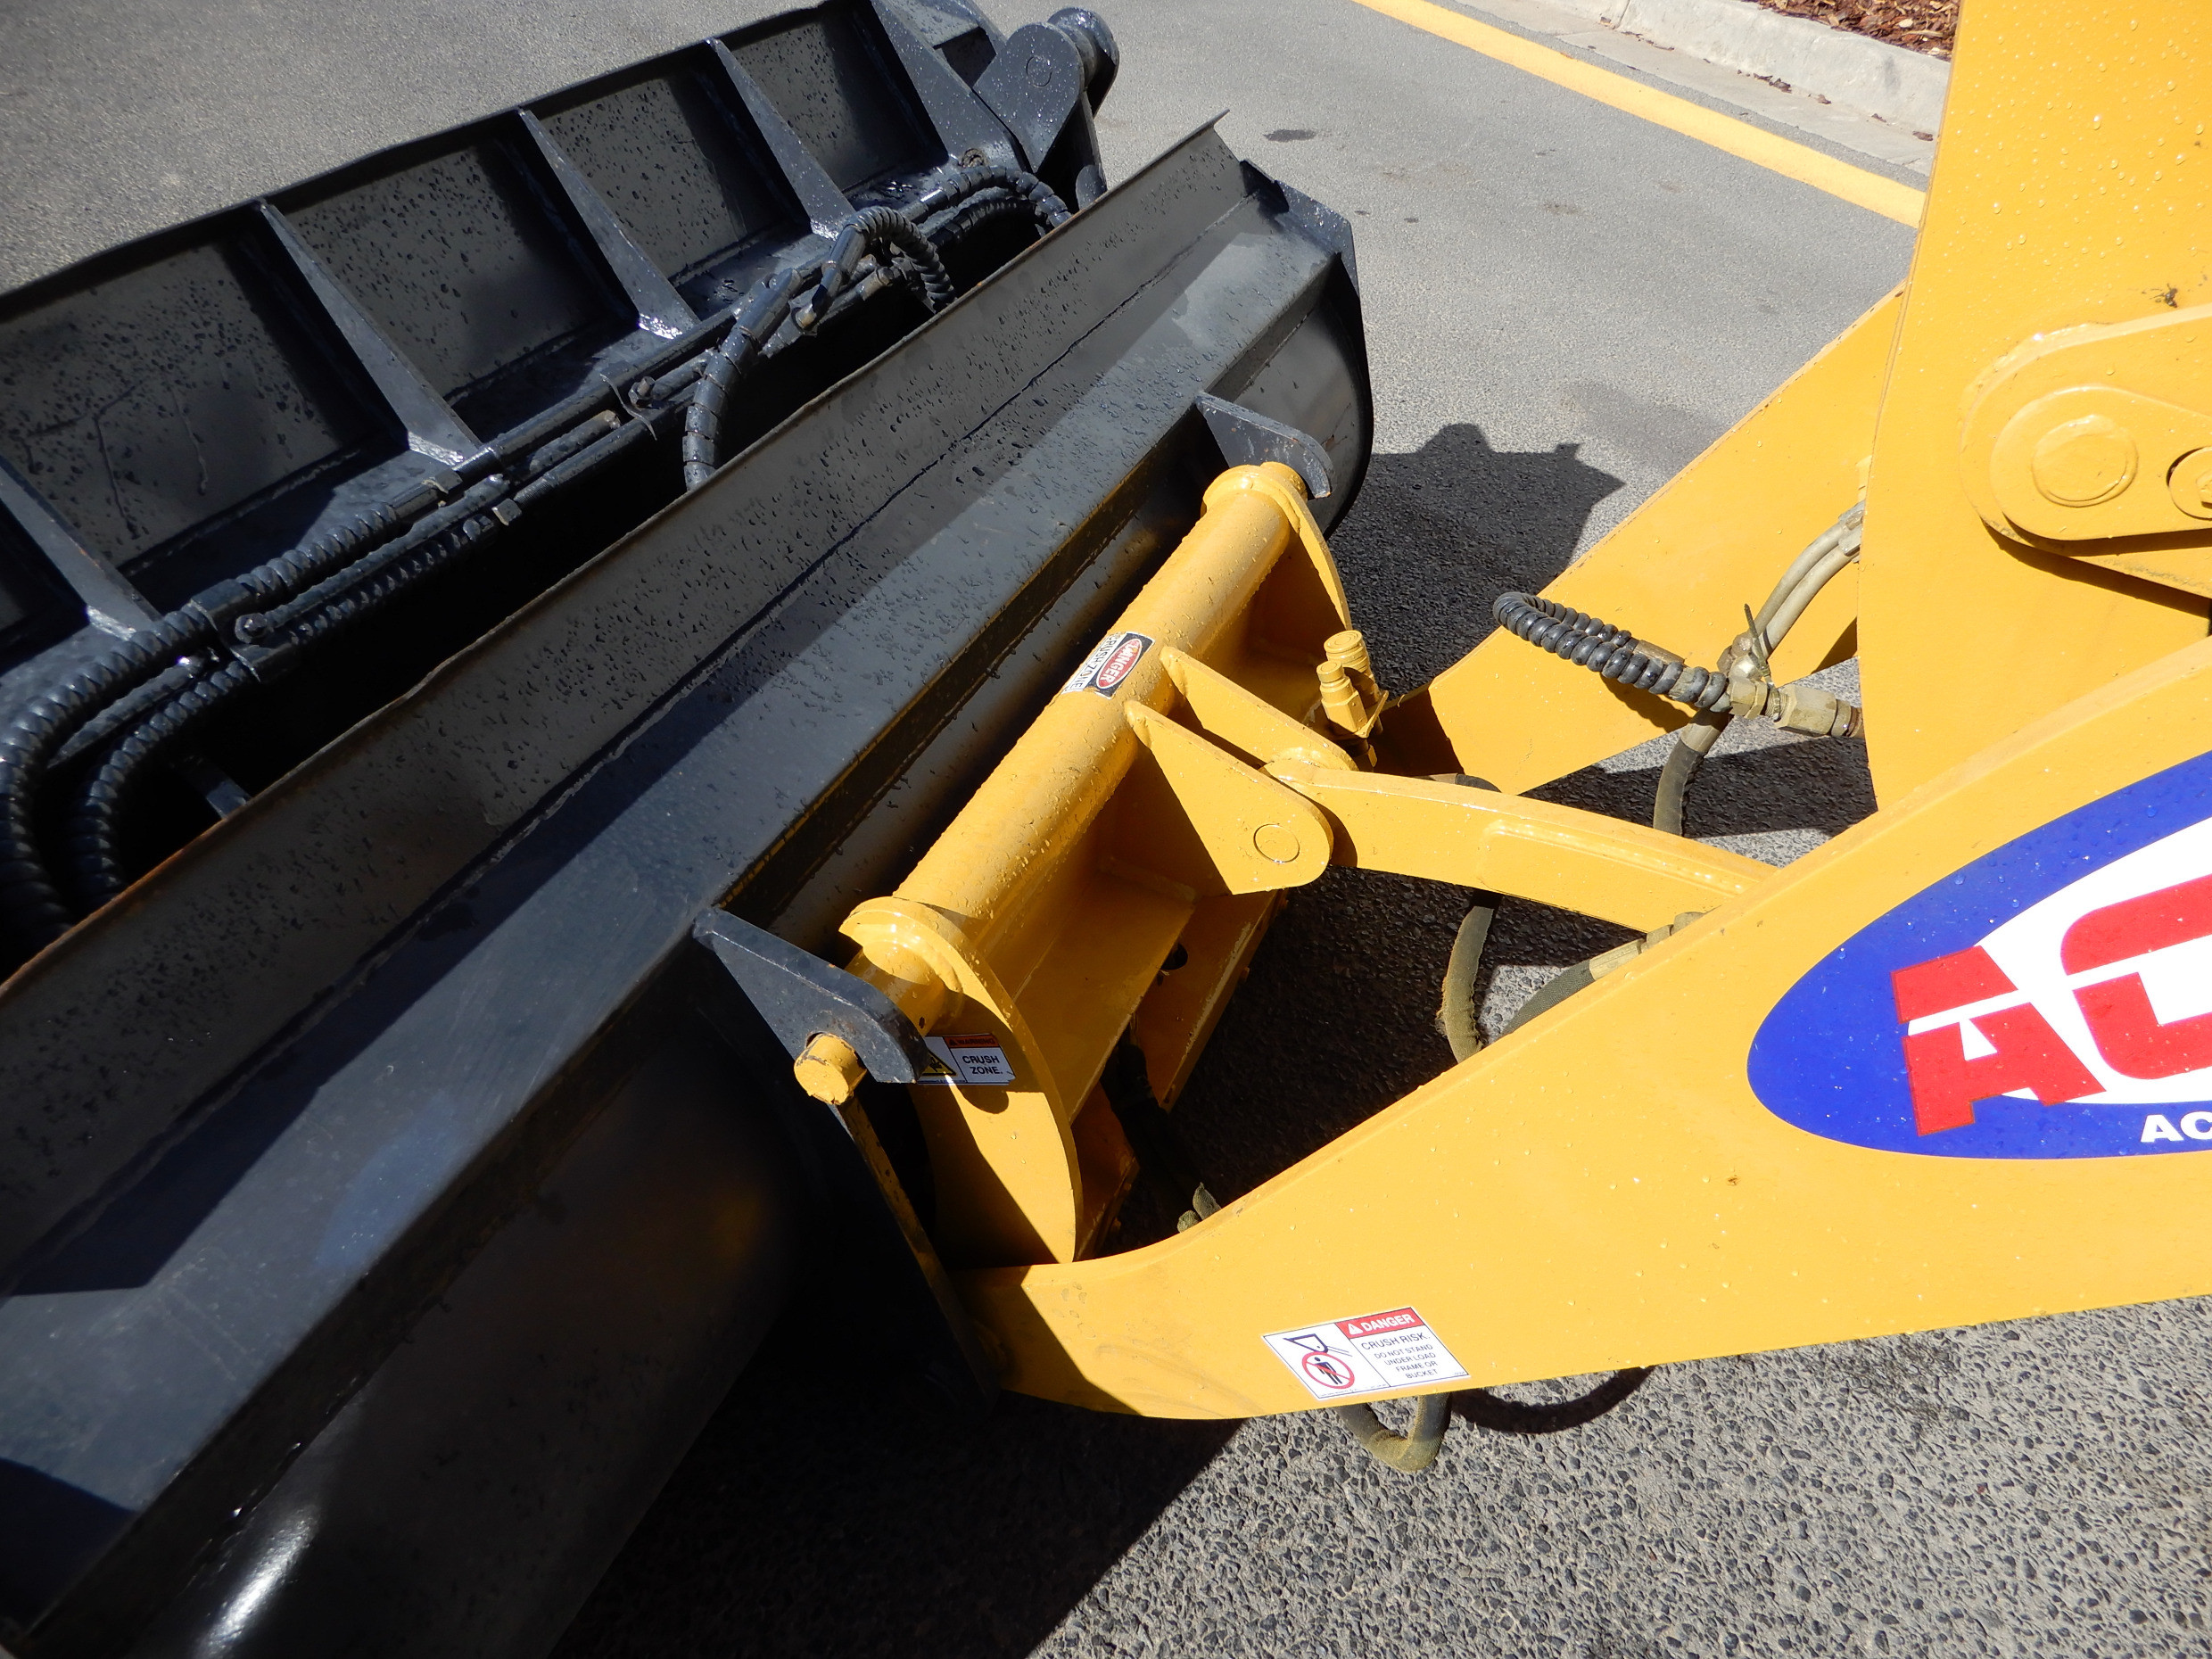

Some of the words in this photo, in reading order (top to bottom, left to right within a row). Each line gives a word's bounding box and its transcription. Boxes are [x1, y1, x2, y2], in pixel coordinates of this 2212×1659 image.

[1100, 643, 1139, 683] DANGER
[962, 1055, 1000, 1064] CRUSH
[970, 1066, 1003, 1075] ZONE.
[1360, 1313, 1416, 1332] DANGER
[1361, 1337, 1400, 1350] CRUSH
[1399, 1333, 1431, 1343] RISK.
[1388, 1349, 1404, 1357] NOT
[1405, 1343, 1433, 1354] STAND
[1384, 1356, 1413, 1366] UNDER
[1414, 1352, 1436, 1361] LOAD
[1395, 1361, 1424, 1373] FRAME
[1405, 1369, 1438, 1379] BUCKET
